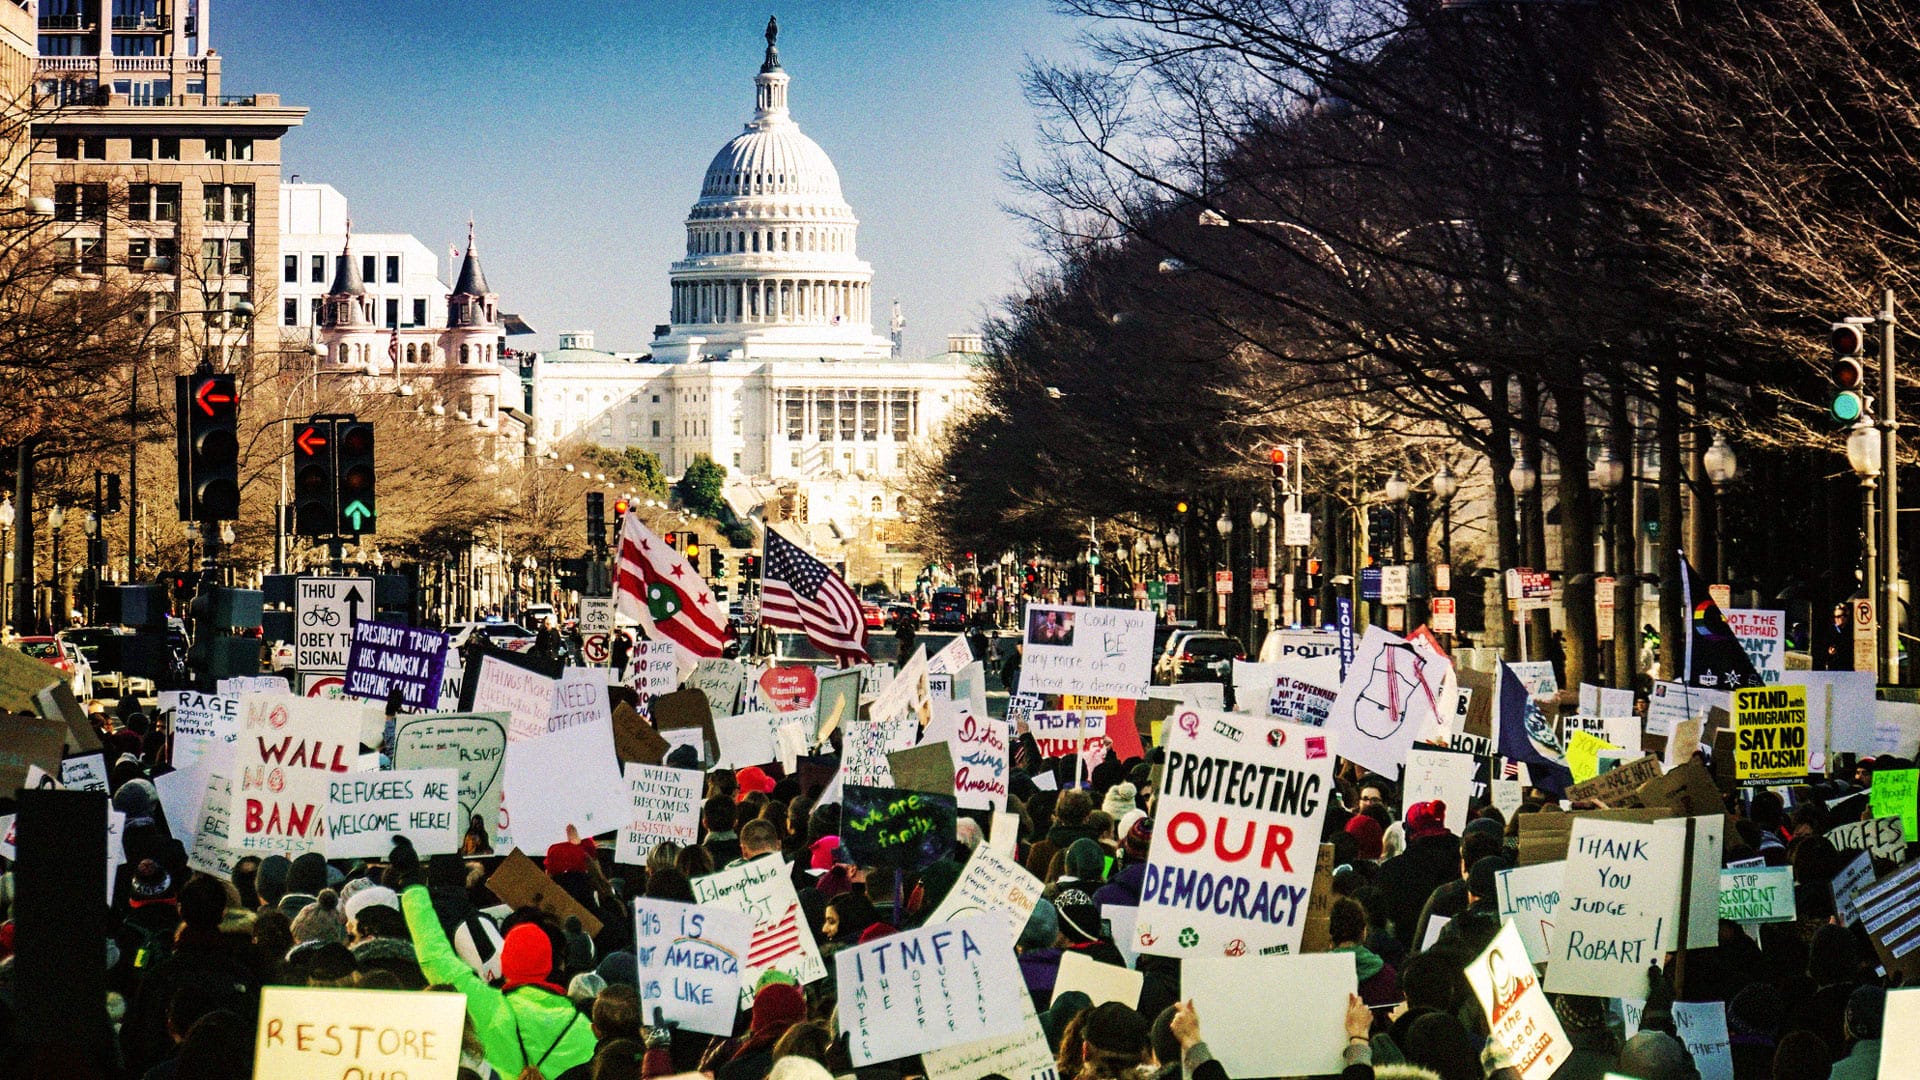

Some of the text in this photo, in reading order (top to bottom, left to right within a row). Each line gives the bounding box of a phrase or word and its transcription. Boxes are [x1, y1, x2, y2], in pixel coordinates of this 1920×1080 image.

[302, 584, 336, 599] THRU
[1084, 612, 1144, 633] Could you
[1753, 615, 1777, 625] THE
[300, 633, 352, 648] OBEY TH
[357, 622, 443, 655] PRESIDENT TRUMP
[1735, 625, 1778, 638] MERMAID
[633, 643, 673, 658] NO HATE
[1103, 633, 1128, 652] BE
[300, 651, 346, 666] SIGNAL
[358, 648, 376, 669] HAS
[634, 660, 647, 675] NO
[635, 677, 647, 690] NO
[179, 692, 239, 716] RAGE
[556, 683, 597, 710] NEED
[1738, 690, 1788, 710] STAND
[246, 702, 288, 730] NO
[1738, 709, 1805, 726] IMMIGRANTS!
[176, 726, 216, 738] WHAT'S
[1739, 727, 1805, 751] SAY NO
[257, 736, 350, 774] WALL
[460, 747, 500, 762] RSVP
[961, 751, 1008, 777] sing
[1739, 749, 1805, 770] to RACISM!
[241, 765, 286, 794] NO
[643, 768, 681, 783] WHEN
[850, 765, 892, 776] MEXICA
[329, 780, 450, 804] REFUGEES ARE
[631, 780, 694, 800] INJUSTICE
[1164, 750, 1321, 819] PROTECTING
[633, 796, 690, 814] BECOMES
[244, 798, 316, 838] BAN
[328, 811, 451, 841] WELCOME HERE!
[646, 811, 676, 823] LAW
[242, 837, 315, 852] #RESIST
[629, 831, 688, 847] BECOMES
[1167, 811, 1294, 874] OUR
[1576, 835, 1649, 862] THANK
[1733, 874, 1759, 889] STOP
[1142, 862, 1308, 928] DEMOCRACY
[1498, 869, 1562, 916] Immigra
[1719, 886, 1777, 906] RESIDENT
[1570, 897, 1628, 916] JUDGE
[1719, 902, 1773, 919] BANNON
[665, 945, 739, 976] AMERICA
[674, 977, 713, 1006] LIKE
[267, 1018, 438, 1061] RESTORE
